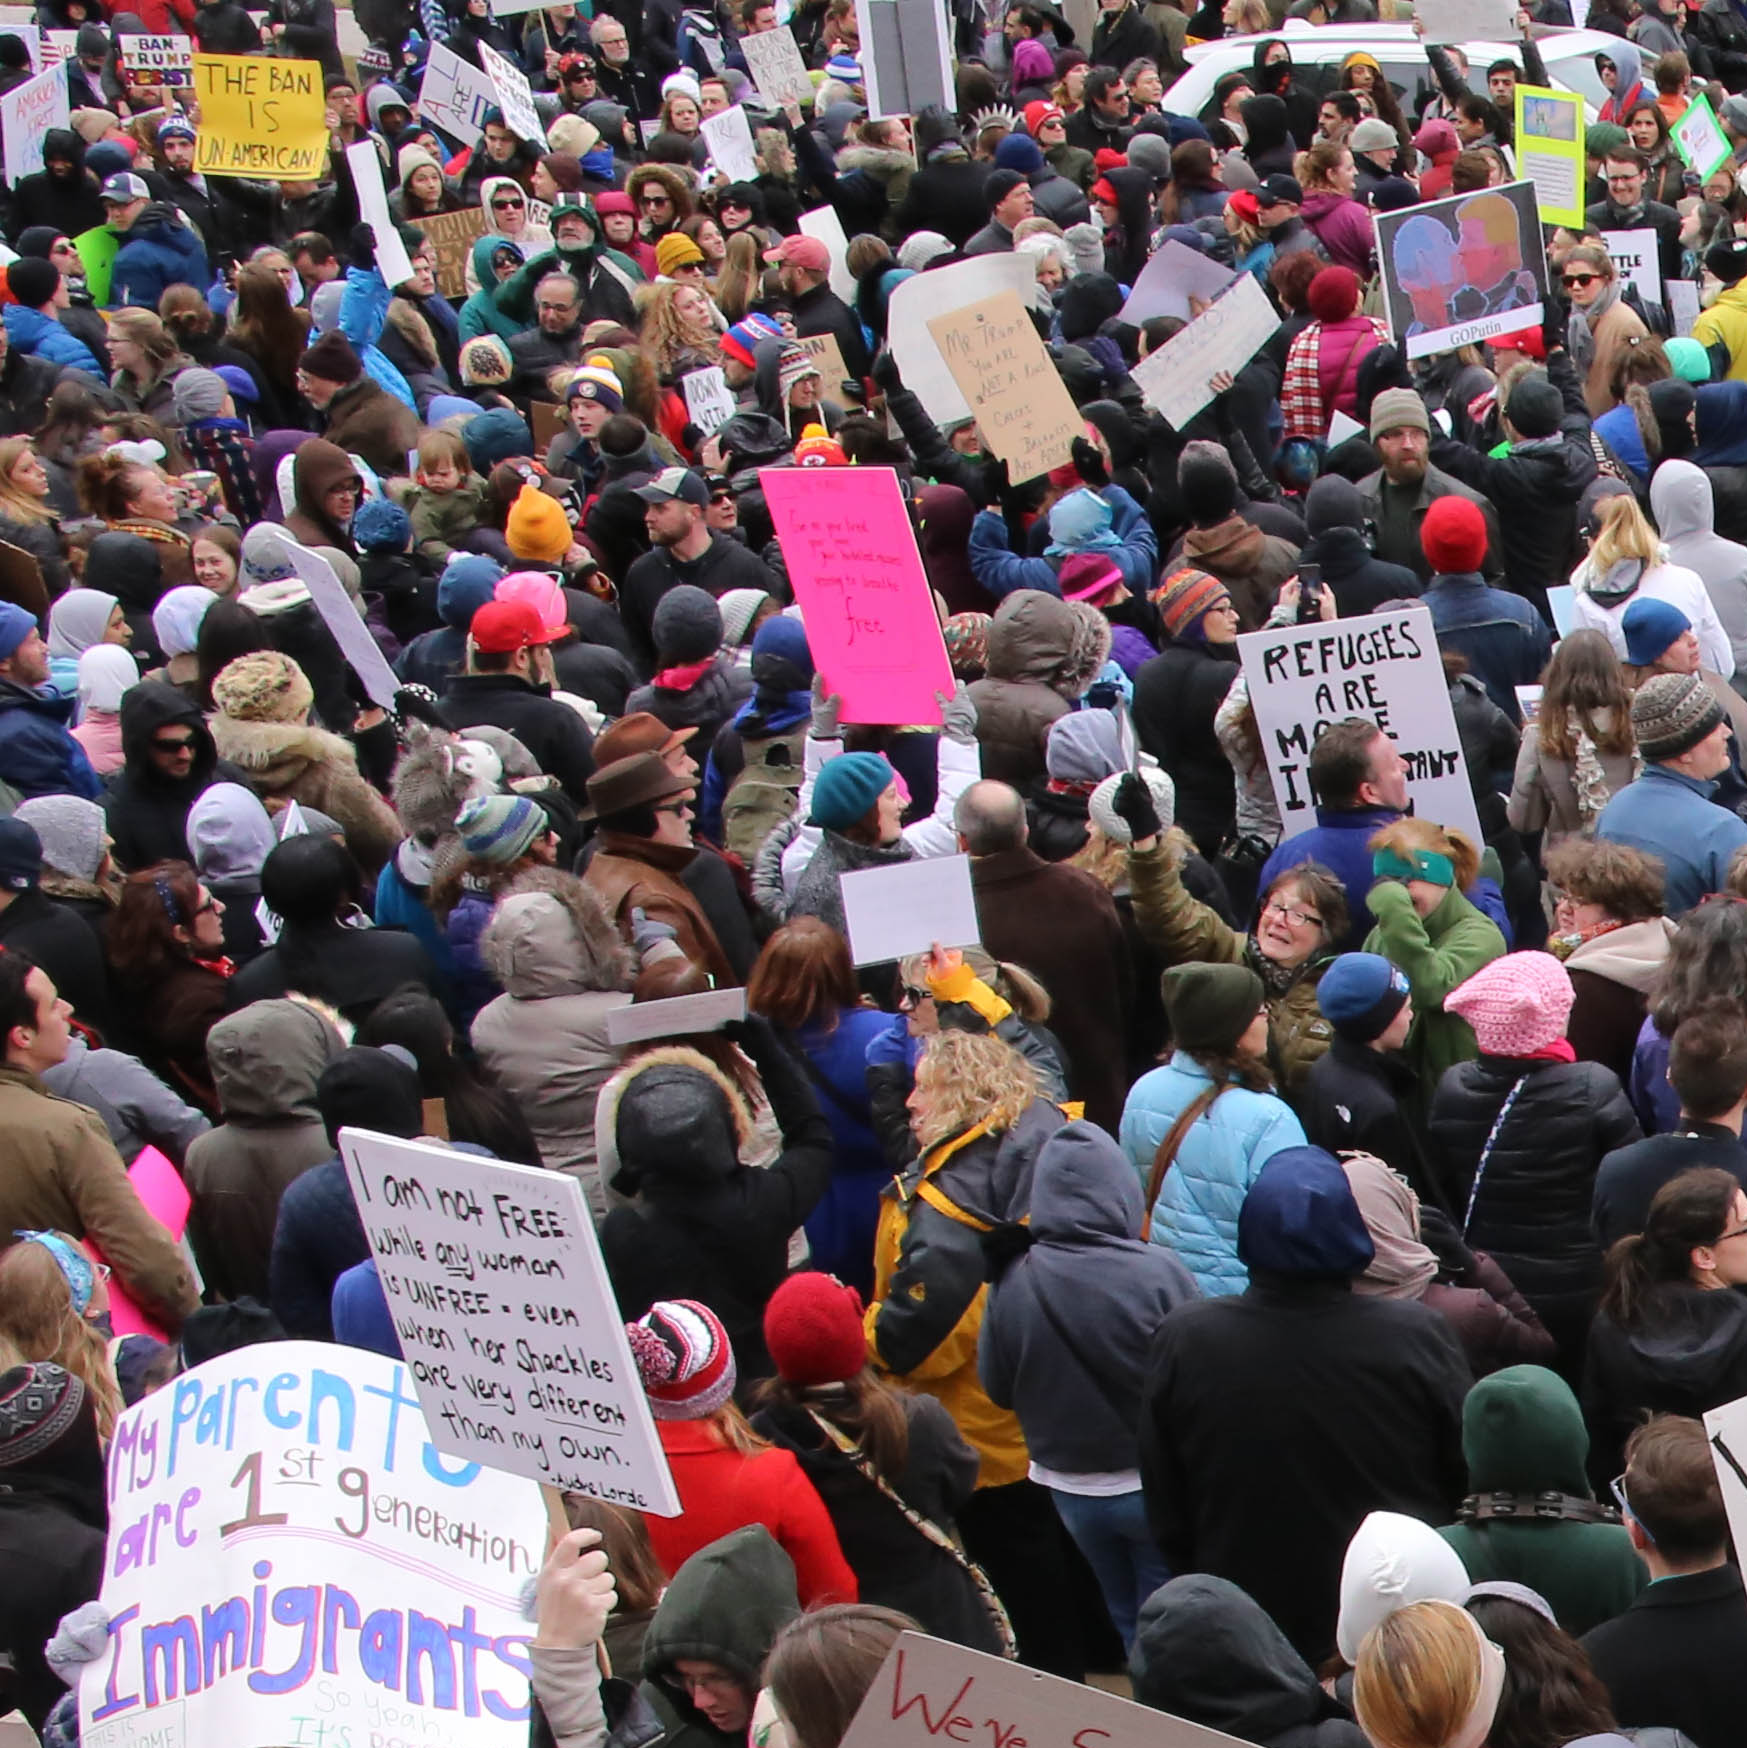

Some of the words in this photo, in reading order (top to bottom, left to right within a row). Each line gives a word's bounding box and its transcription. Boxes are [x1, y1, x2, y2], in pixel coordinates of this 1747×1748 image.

[125, 52, 192, 66] TRUMP
[125, 69, 195, 88] RESIST
[203, 61, 259, 96] THE
[270, 66, 312, 95] BAN
[248, 100, 281, 133] IS
[198, 135, 320, 171] UN-AMERICAN!
[1449, 324, 1504, 347] GOPutin
[843, 595, 886, 648] free
[1262, 619, 1423, 686] REFUGEES
[1313, 674, 1388, 713] ARE
[352, 1149, 371, 1203] I
[382, 1175, 432, 1211] am
[436, 1187, 483, 1227] not
[435, 1241, 476, 1281] any
[478, 1250, 565, 1280] woman
[382, 1269, 401, 1295] is
[404, 1277, 491, 1316] UNFREE
[523, 1303, 580, 1327] even
[396, 1319, 455, 1352] when
[469, 1330, 505, 1365] her
[413, 1359, 457, 1391] are
[462, 1373, 515, 1415] very
[527, 1377, 626, 1428] different
[110, 1404, 160, 1505] My
[441, 1399, 505, 1444] than
[512, 1432, 551, 1471] my
[599, 1485, 648, 1507] Lorde
[113, 1483, 201, 1578] are
[91, 1559, 534, 1723] Immigrants
[119, 1720, 135, 1741] IS
